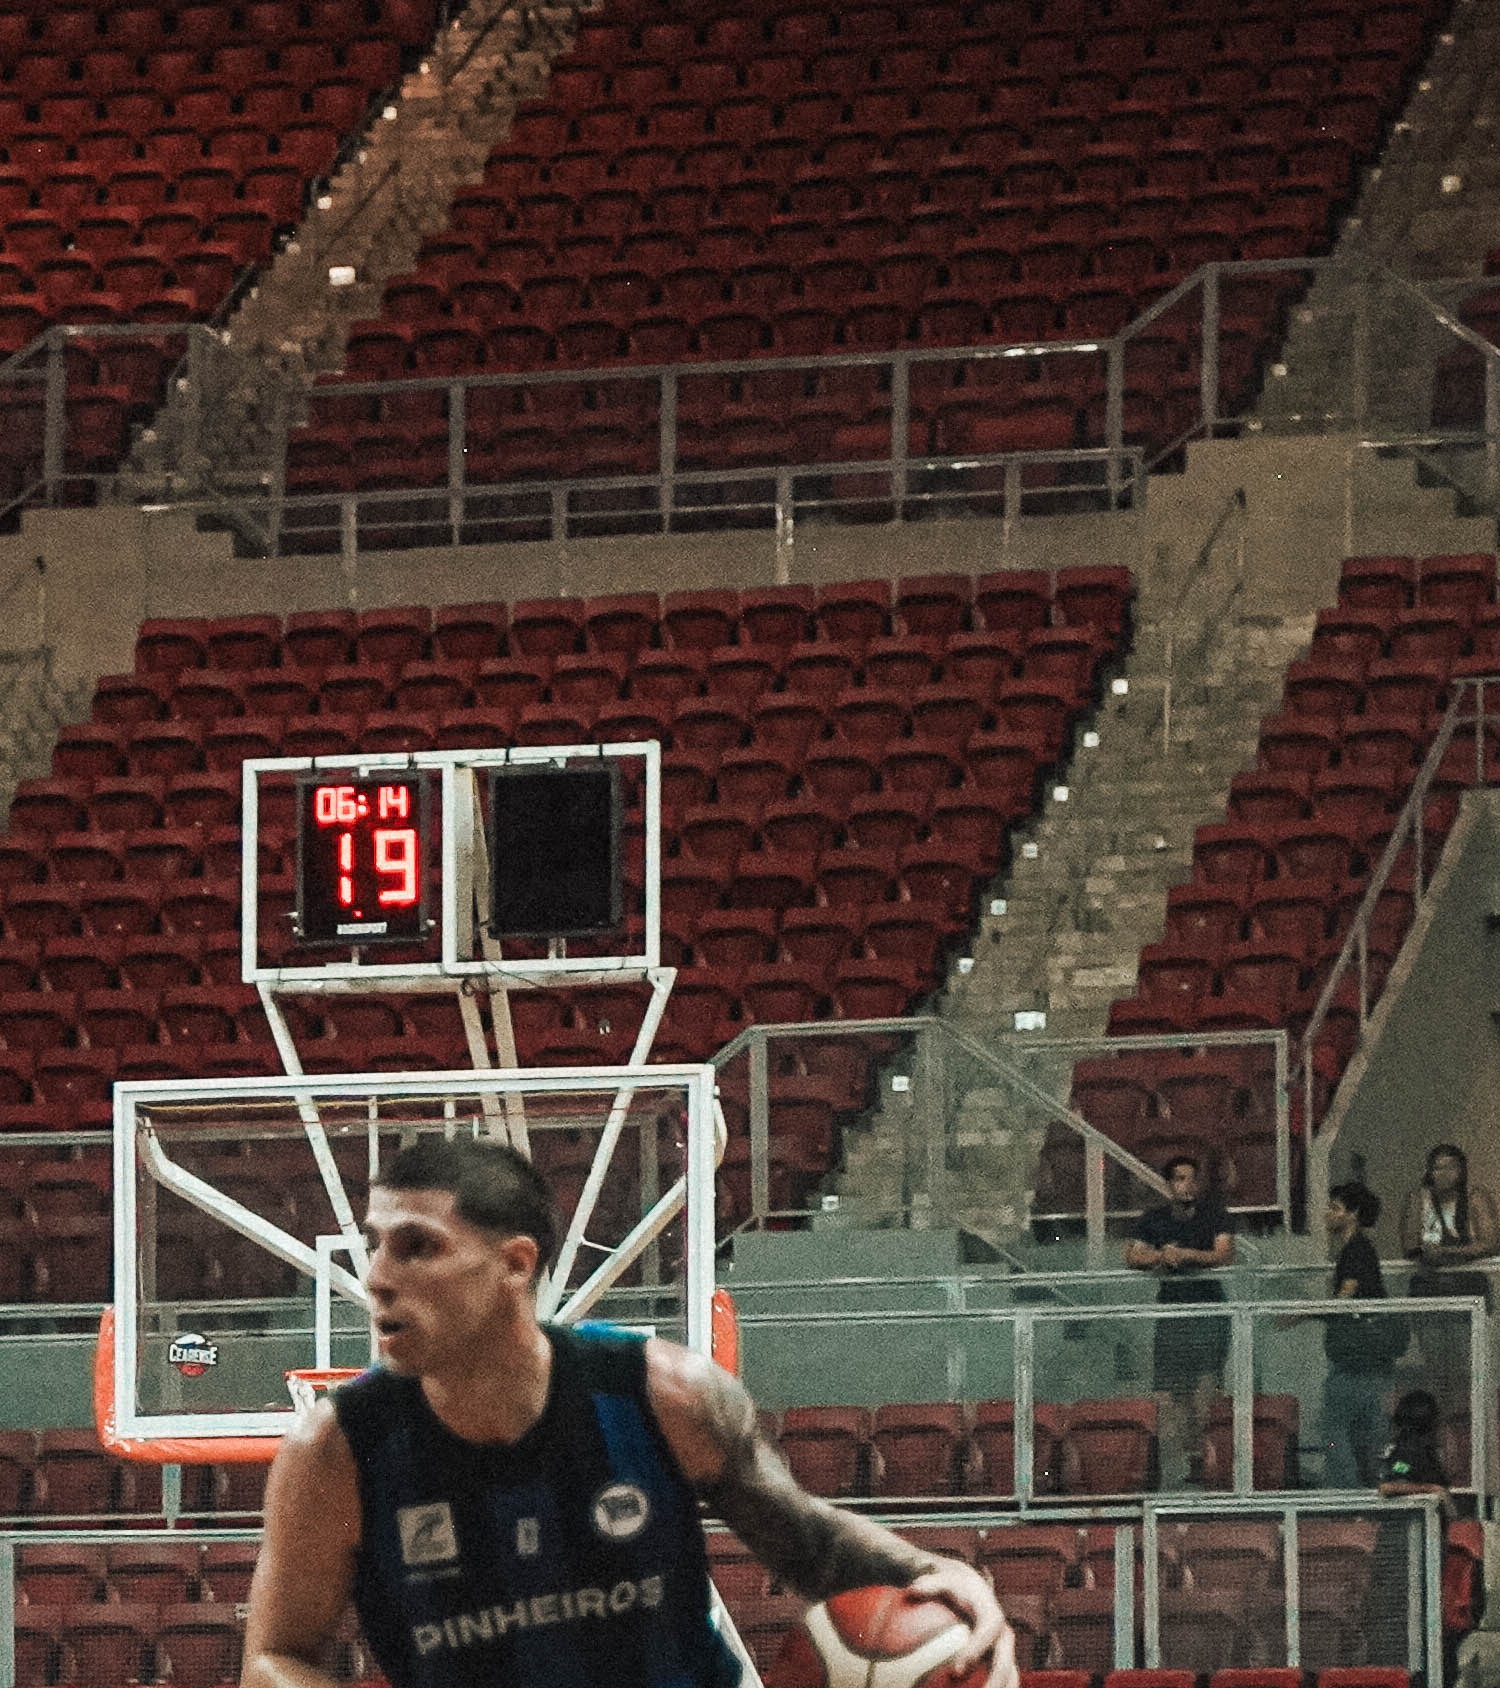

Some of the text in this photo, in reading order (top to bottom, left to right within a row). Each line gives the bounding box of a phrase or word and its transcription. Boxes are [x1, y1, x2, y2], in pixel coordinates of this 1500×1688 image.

[315, 785, 409, 823] 06:14
[339, 829, 417, 904] 19
[413, 1575, 666, 1656] PINHEIROS
